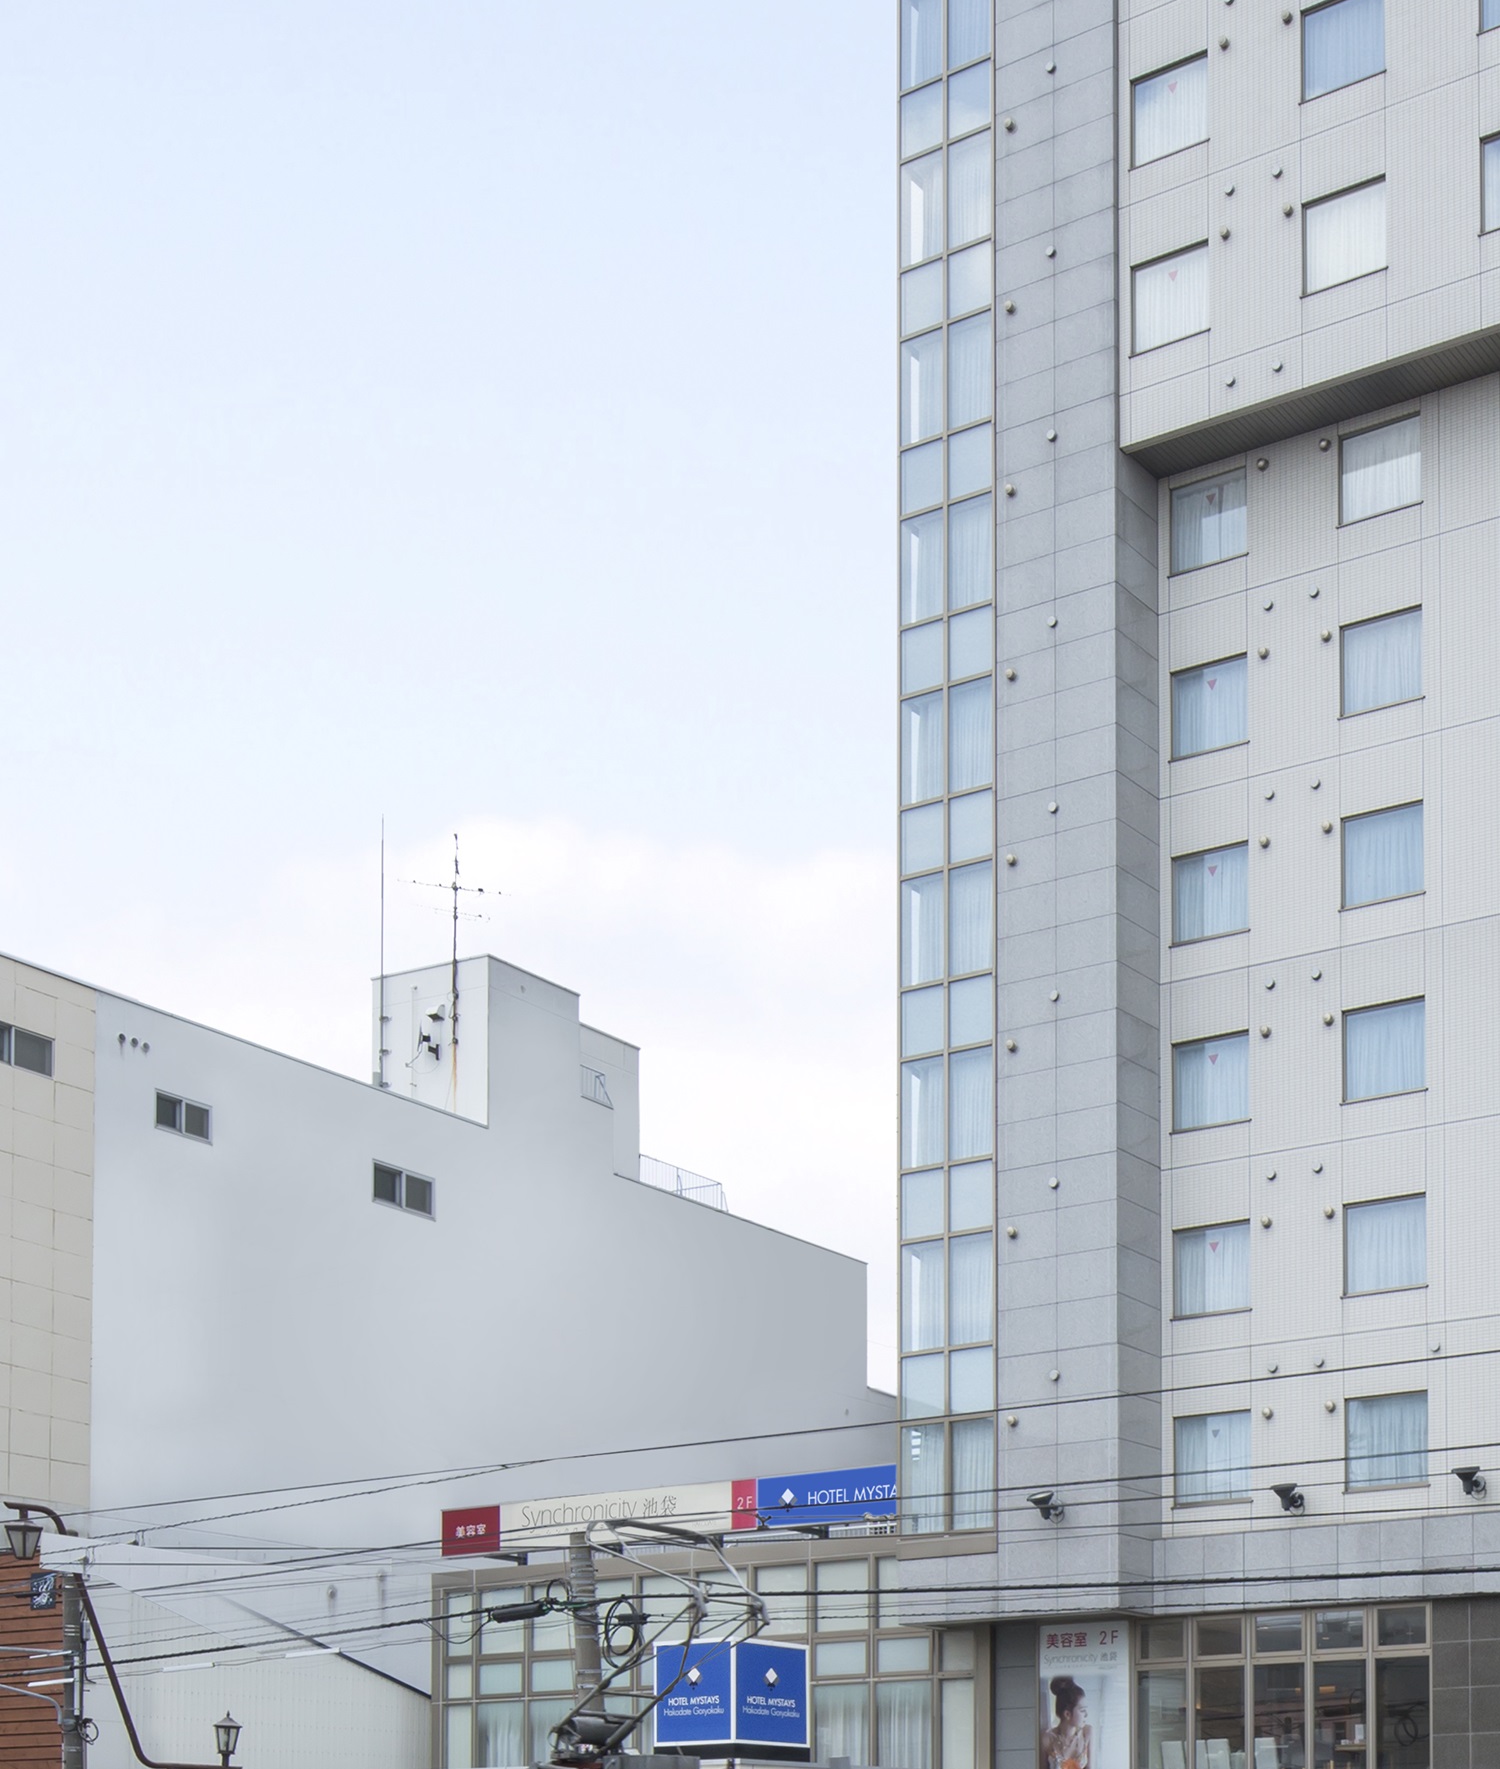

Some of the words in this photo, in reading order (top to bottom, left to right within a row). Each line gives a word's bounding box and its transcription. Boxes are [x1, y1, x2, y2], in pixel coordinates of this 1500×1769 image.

[736, 1496, 752, 1511] 2F
[808, 1488, 849, 1506] HOTEL
[521, 1498, 638, 1533] Synchronicity
[643, 1495, 677, 1517] 池袋
[455, 1523, 487, 1539] 美容室
[1046, 1632, 1087, 1649] 美容室
[1099, 1630, 1119, 1645] 2F
[1043, 1652, 1099, 1666] Synchronicity
[668, 1697, 688, 1706] HOTEL
[690, 1695, 720, 1705] MYSTAYS
[746, 1696, 767, 1705] HOTEL
[768, 1698, 796, 1708] MYSTAYS
[663, 1707, 691, 1716] Hakodate
[693, 1706, 724, 1716] Goryokaku
[742, 1706, 769, 1715] Hakodate
[770, 1707, 800, 1718] Goryokaku
